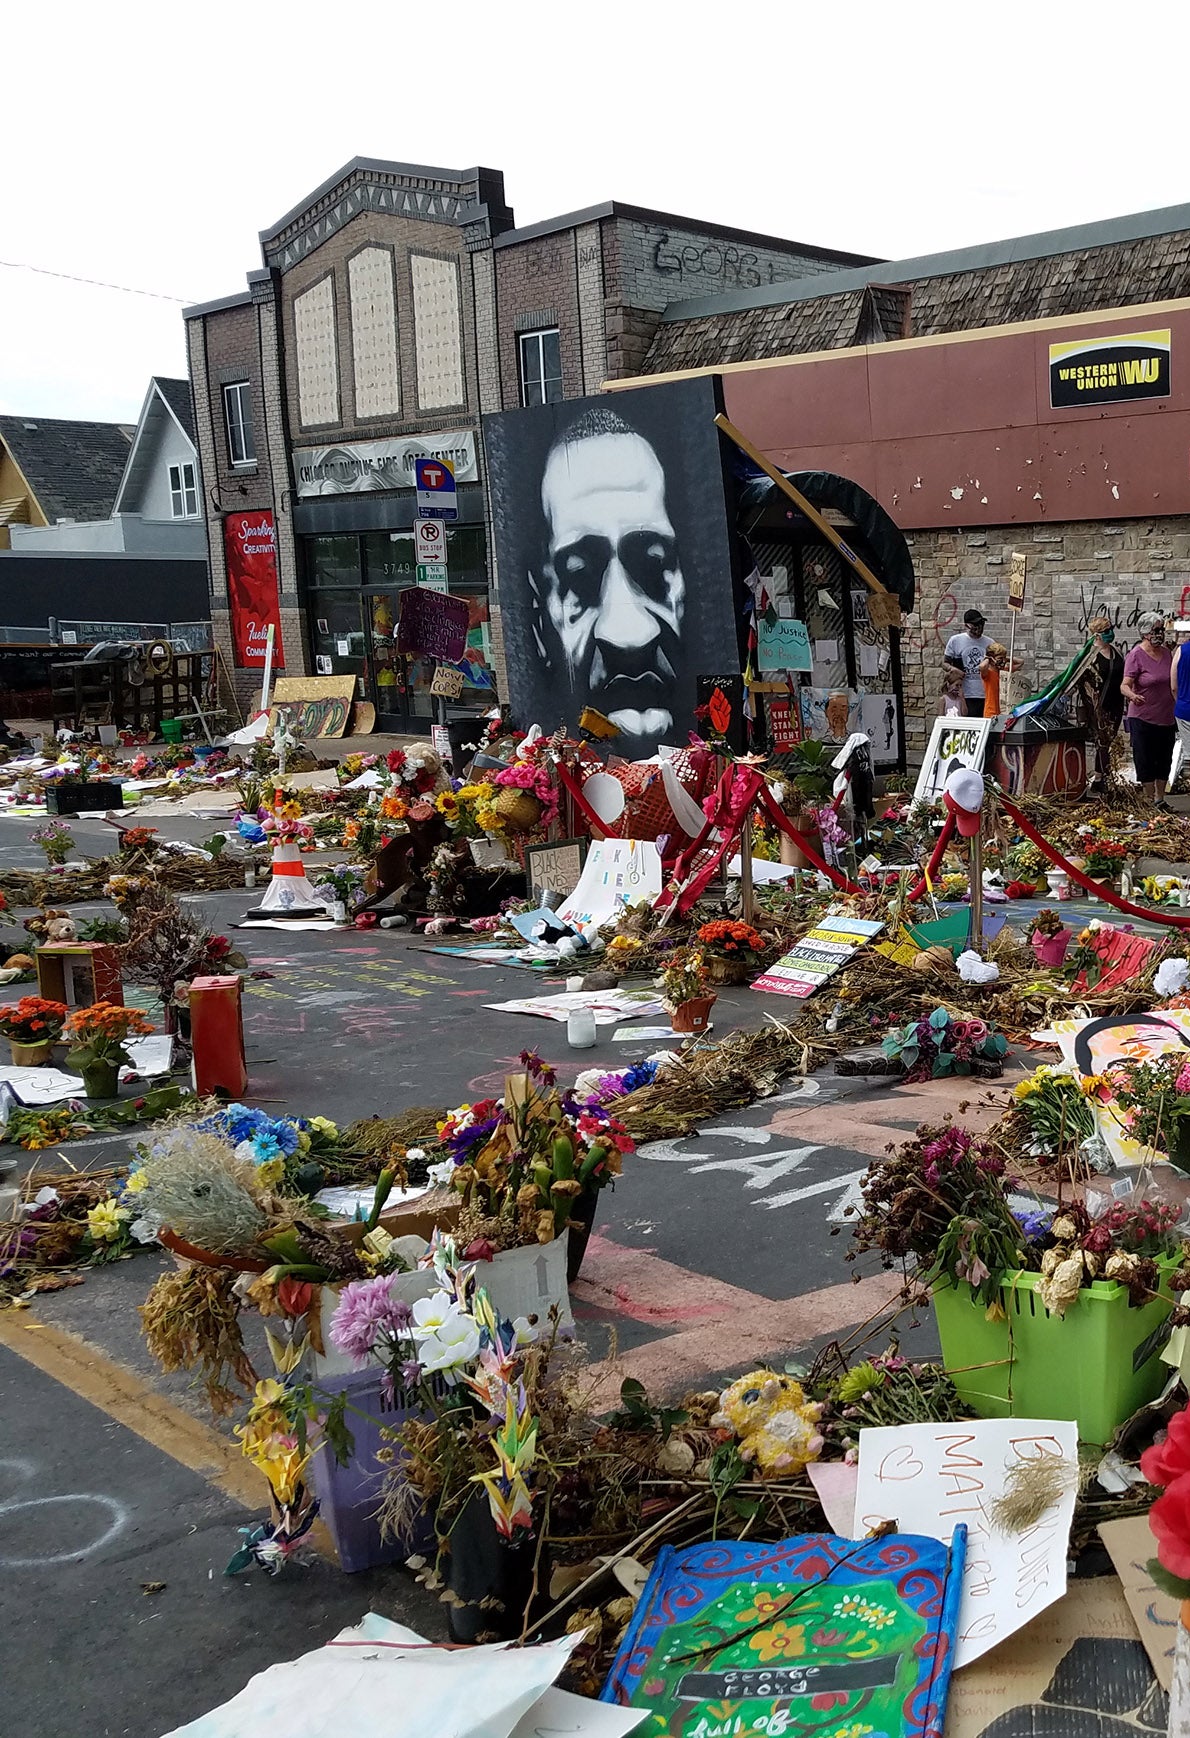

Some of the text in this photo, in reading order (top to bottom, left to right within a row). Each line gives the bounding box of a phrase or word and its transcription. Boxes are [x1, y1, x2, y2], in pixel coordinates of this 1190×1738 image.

[1059, 357, 1160, 385] WESTERN WU
[1076, 375, 1118, 391] UNION
[238, 519, 276, 542] Sparking
[419, 544, 443, 552] BUS STOP
[383, 562, 411, 576] 3749
[762, 624, 808, 639] NO Justice
[774, 731, 800, 742] FIGHT
[723, 1667, 821, 1684] GEORGE
